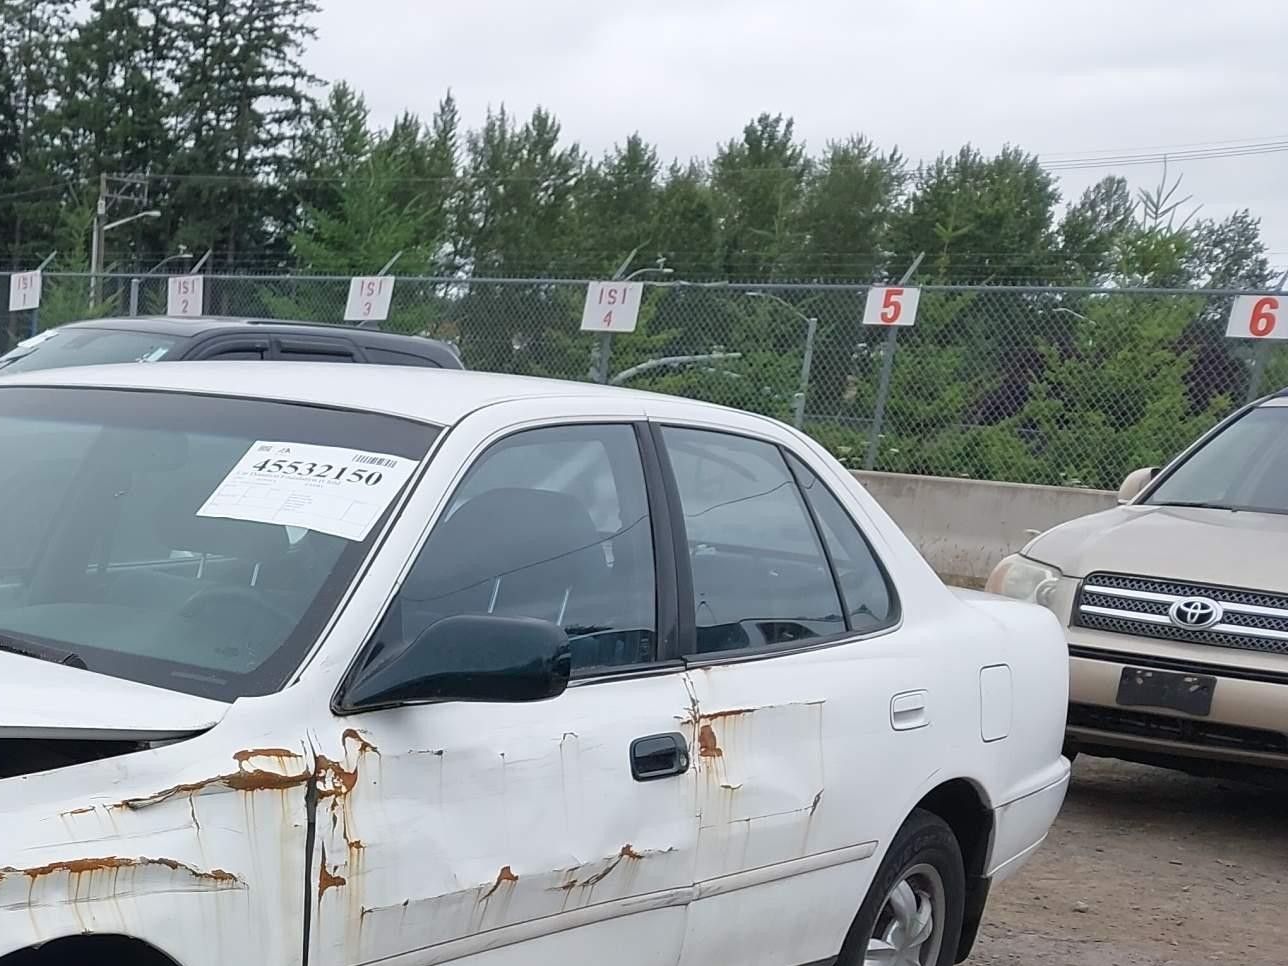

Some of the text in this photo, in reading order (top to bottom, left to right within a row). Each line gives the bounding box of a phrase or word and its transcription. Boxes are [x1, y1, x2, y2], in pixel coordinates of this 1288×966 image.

[182, 299, 189, 314] 2
[363, 301, 372, 317] 3
[880, 288, 905, 324] 5
[1249, 296, 1279, 337] 6
[603, 310, 613, 328] 4
[252, 458, 383, 487] 45532150
